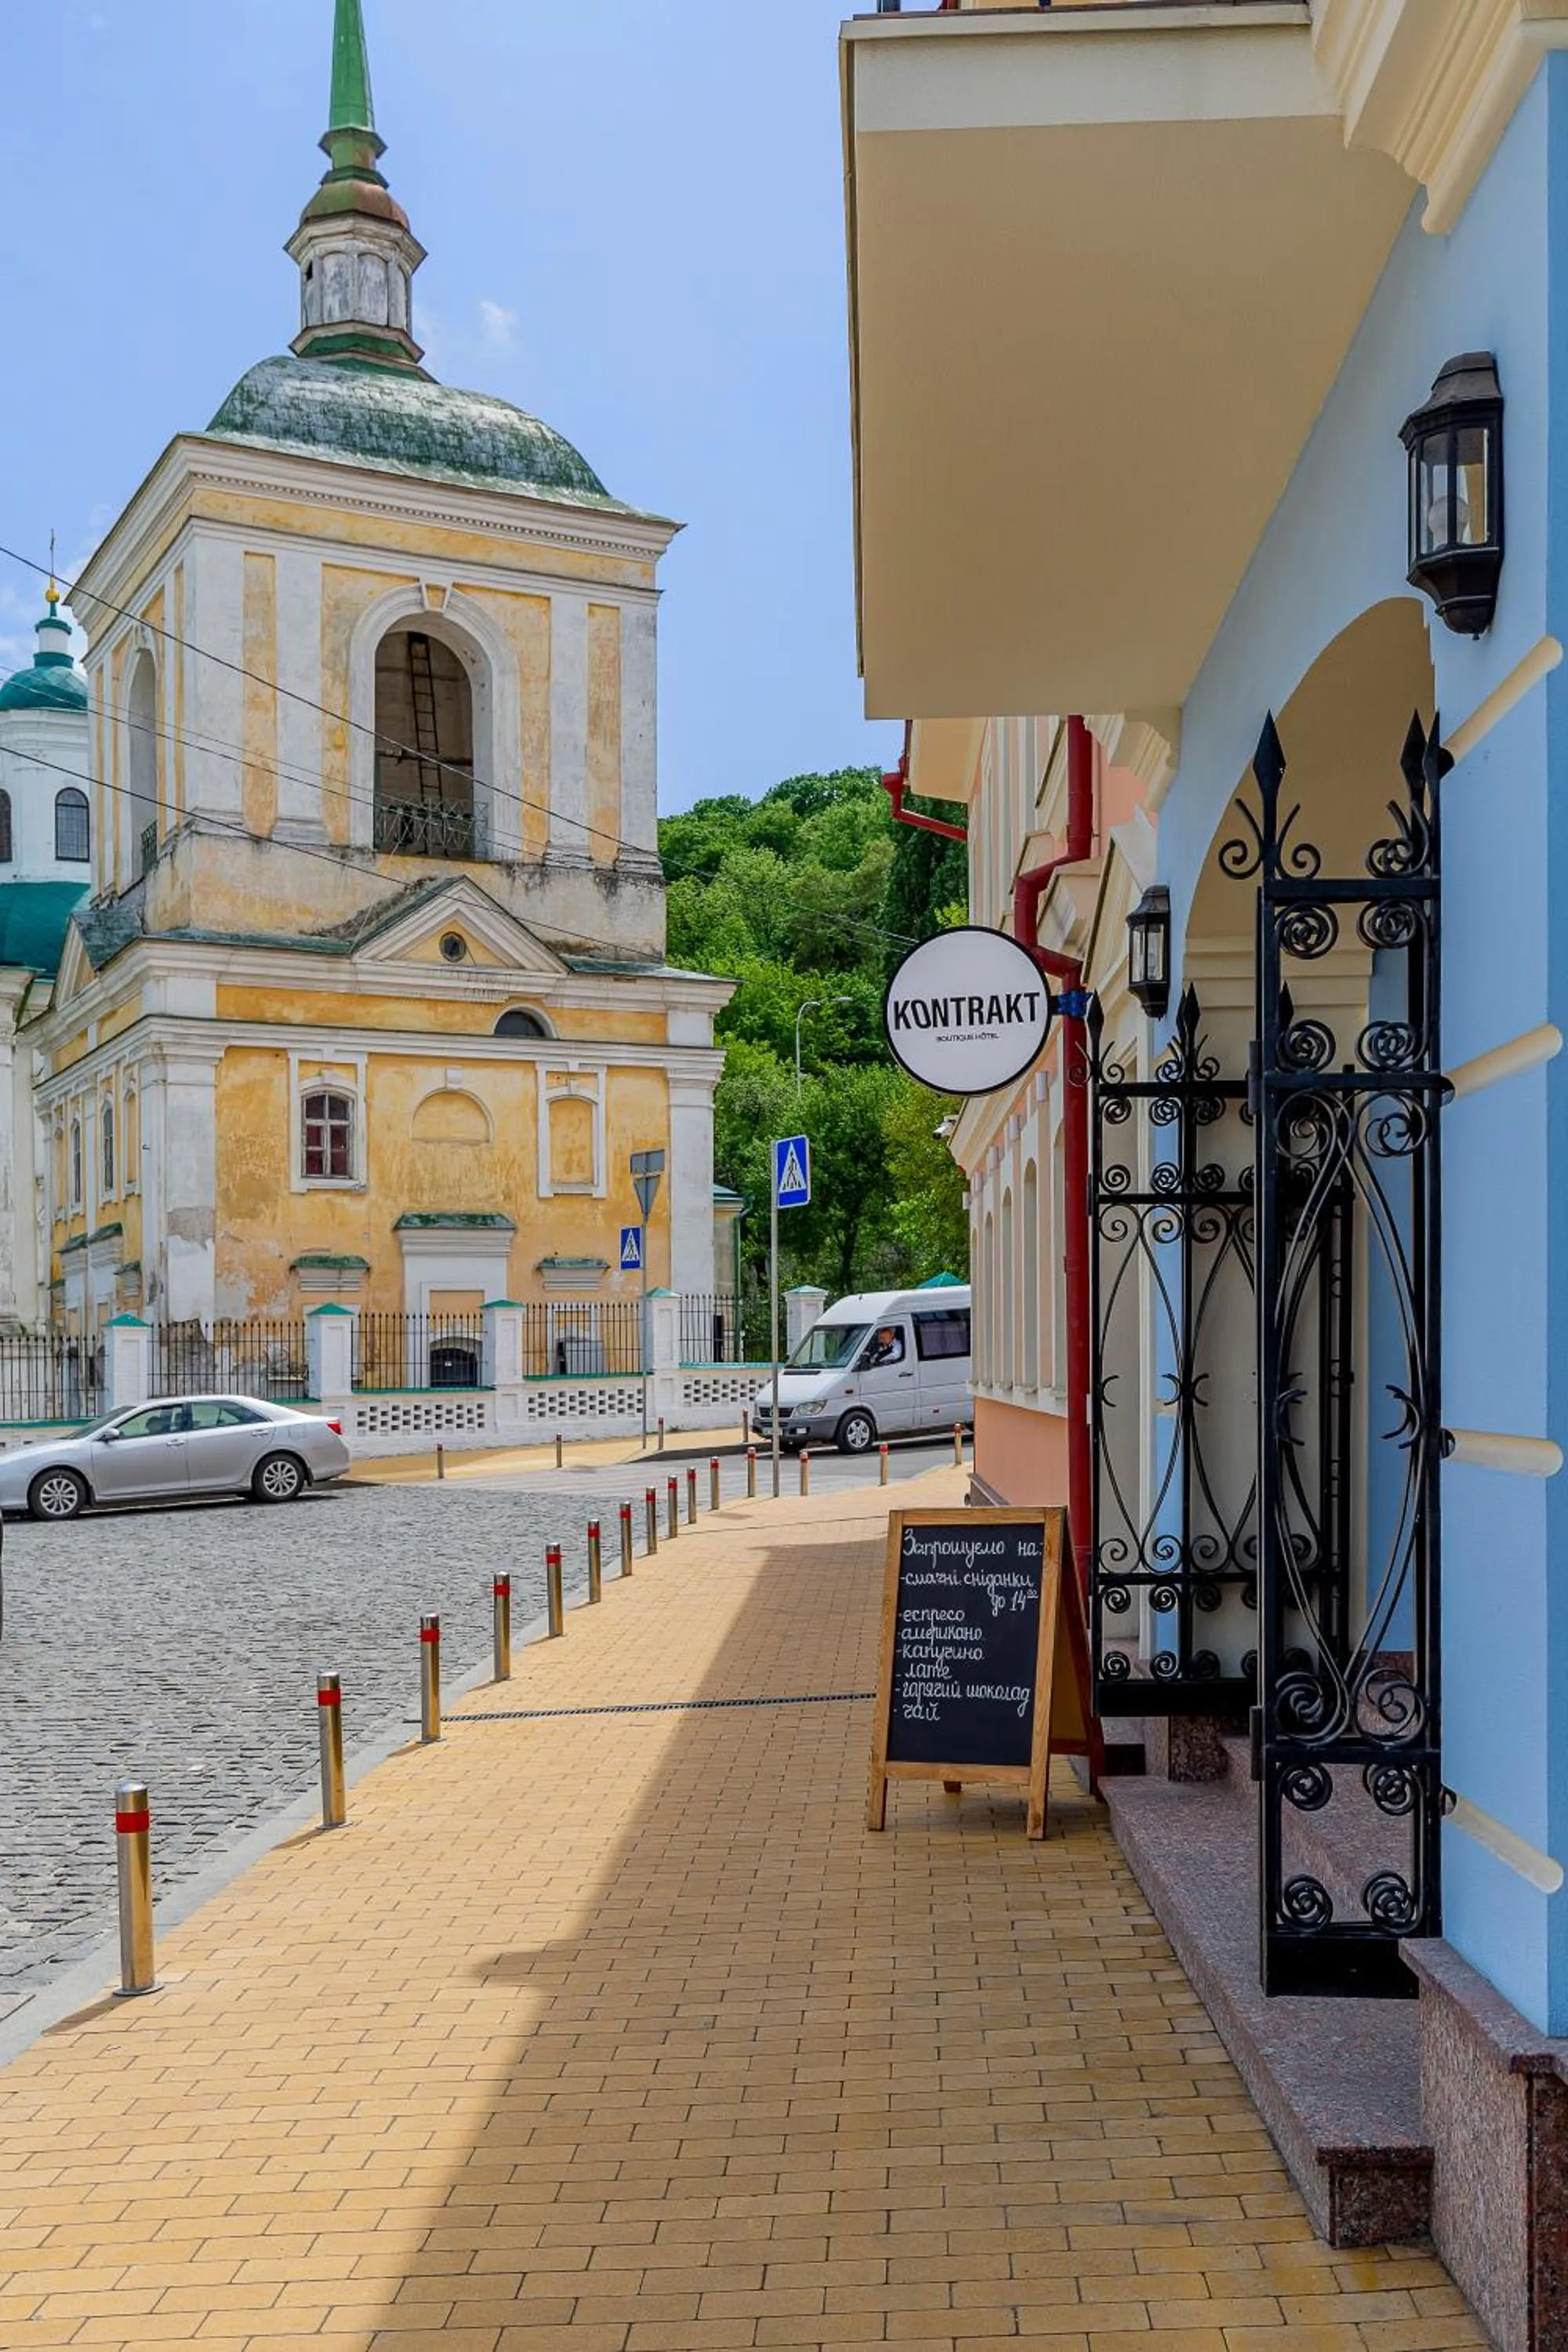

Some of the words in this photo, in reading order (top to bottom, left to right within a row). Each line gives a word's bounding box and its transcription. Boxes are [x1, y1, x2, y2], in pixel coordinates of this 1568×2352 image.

[893, 992, 1040, 1030] KONTRAKT
[964, 1569, 1034, 1597] сніданки
[991, 1593, 1006, 1617] до
[967, 1685, 1031, 1718] шоколад
